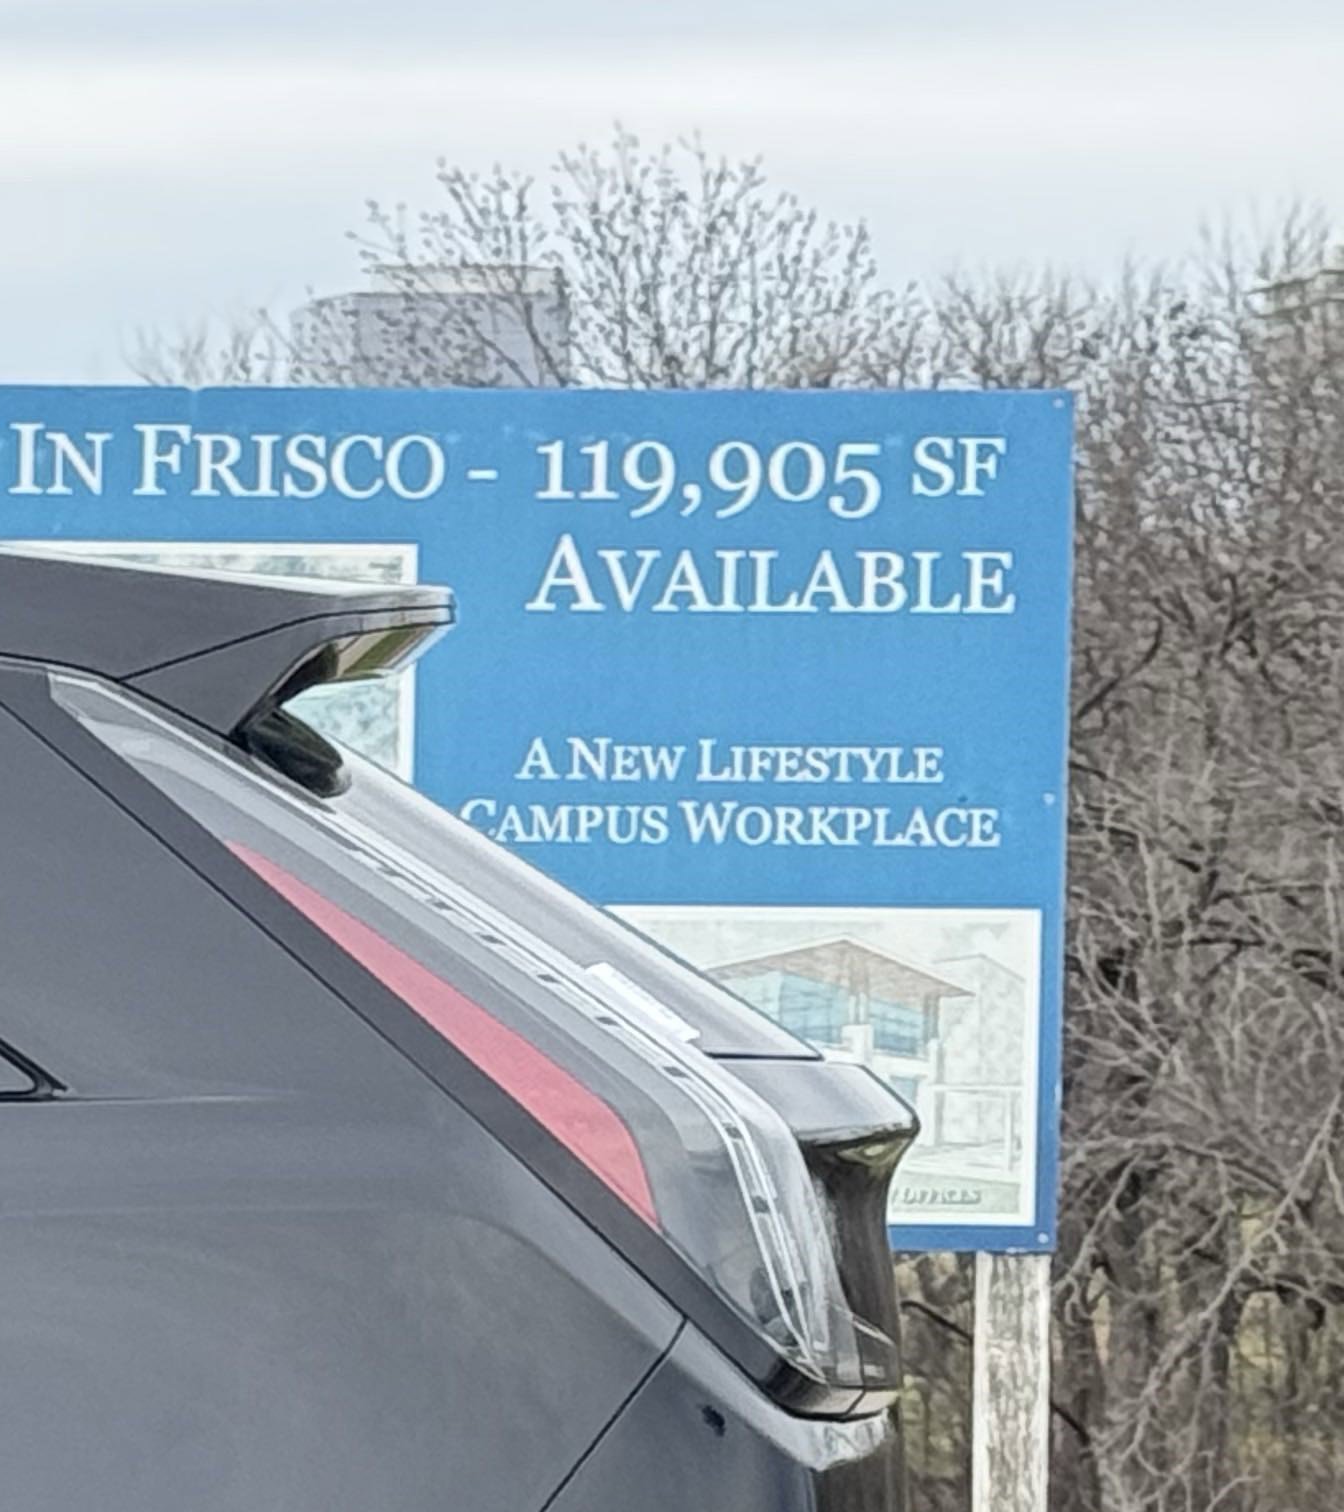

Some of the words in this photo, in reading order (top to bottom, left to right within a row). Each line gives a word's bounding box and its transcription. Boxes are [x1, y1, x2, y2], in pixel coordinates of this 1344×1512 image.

[8, 421, 114, 497] IN
[131, 422, 447, 501] FRISCO
[534, 439, 883, 520] 119,905
[911, 435, 1007, 498] SF
[524, 532, 1017, 614] AVAILABLE
[514, 736, 561, 782] A
[565, 737, 687, 783] NEW
[695, 738, 944, 784] LIFESTYLE
[459, 797, 669, 845] CAMPUS
[677, 799, 1001, 849] WORKPLACE
